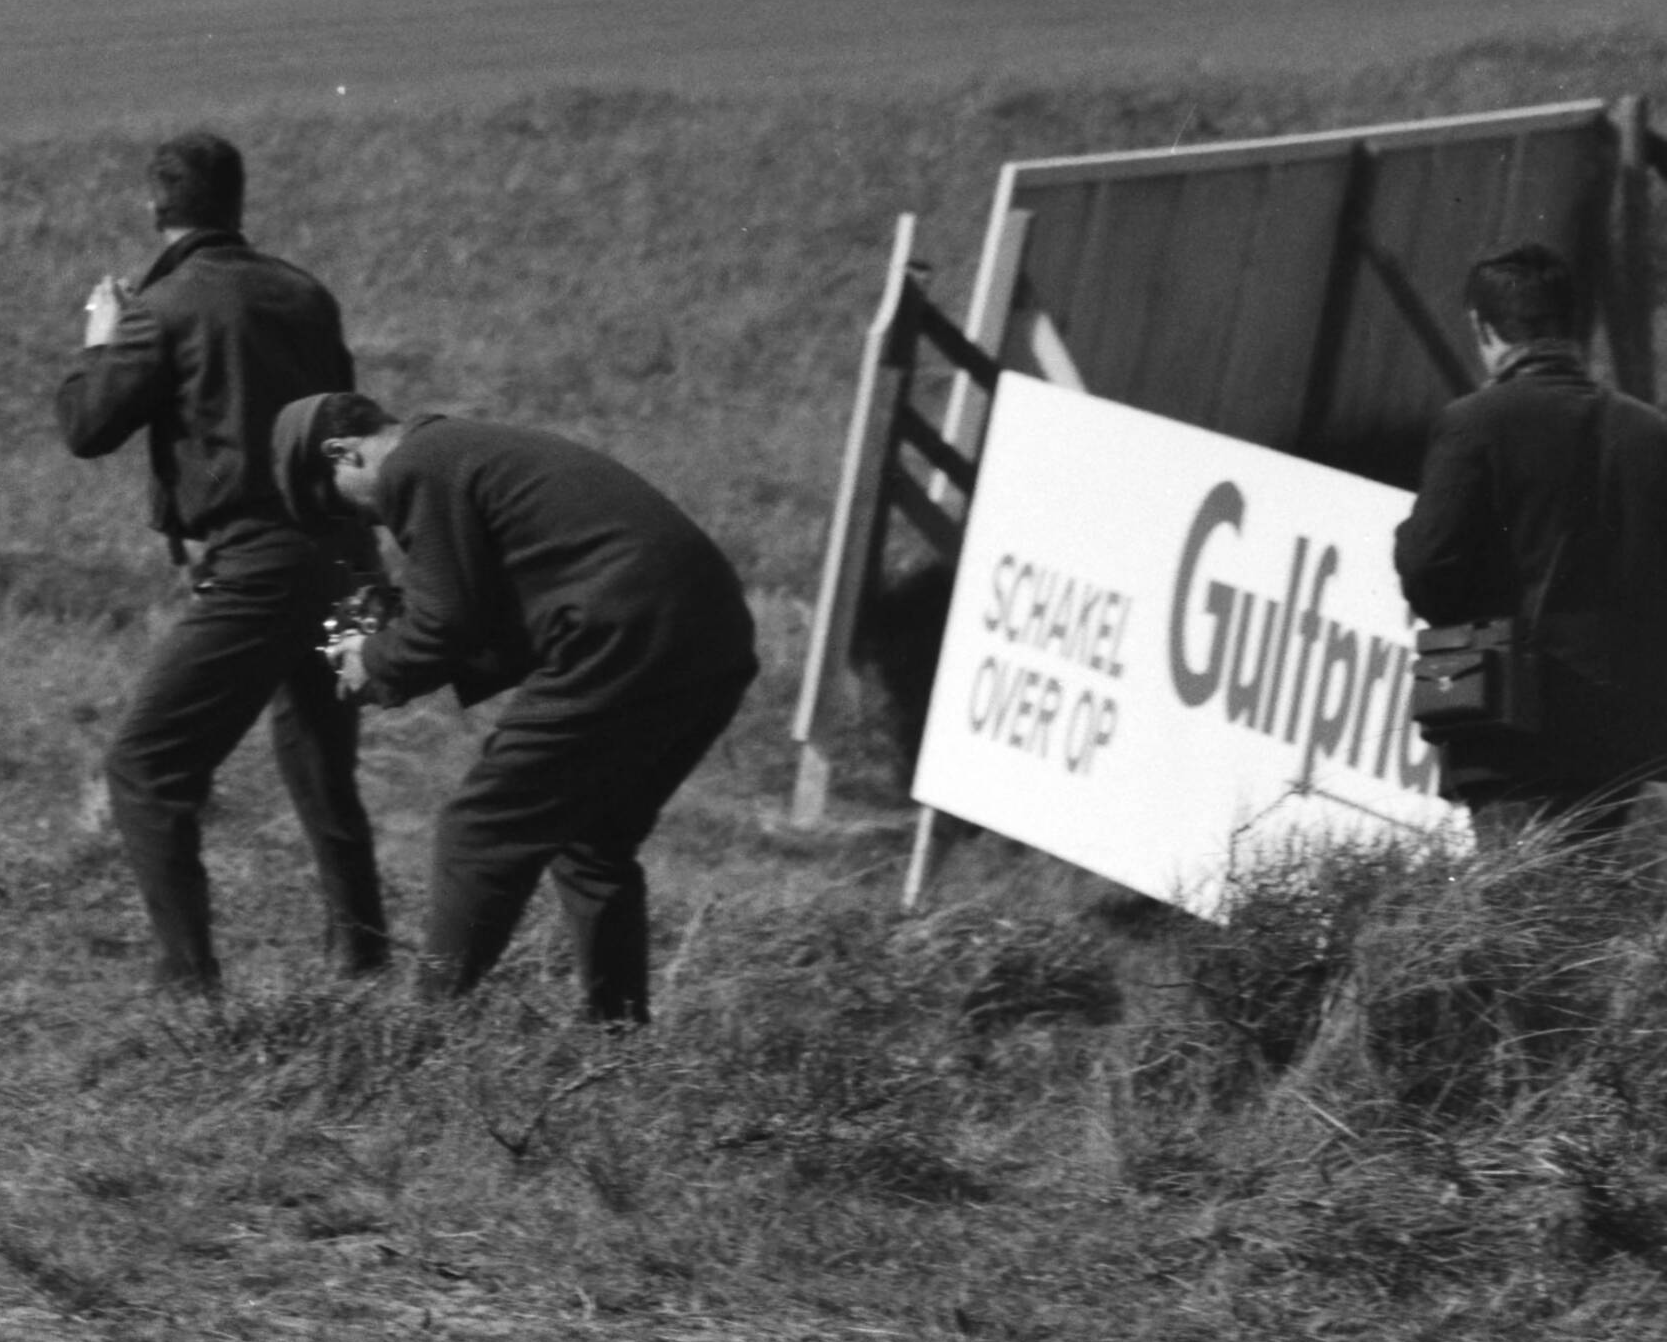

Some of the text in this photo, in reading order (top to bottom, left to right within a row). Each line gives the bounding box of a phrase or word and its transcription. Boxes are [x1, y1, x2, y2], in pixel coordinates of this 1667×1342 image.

[983, 554, 1133, 679] SCHAKEL
[970, 656, 1119, 777] OVER OP
